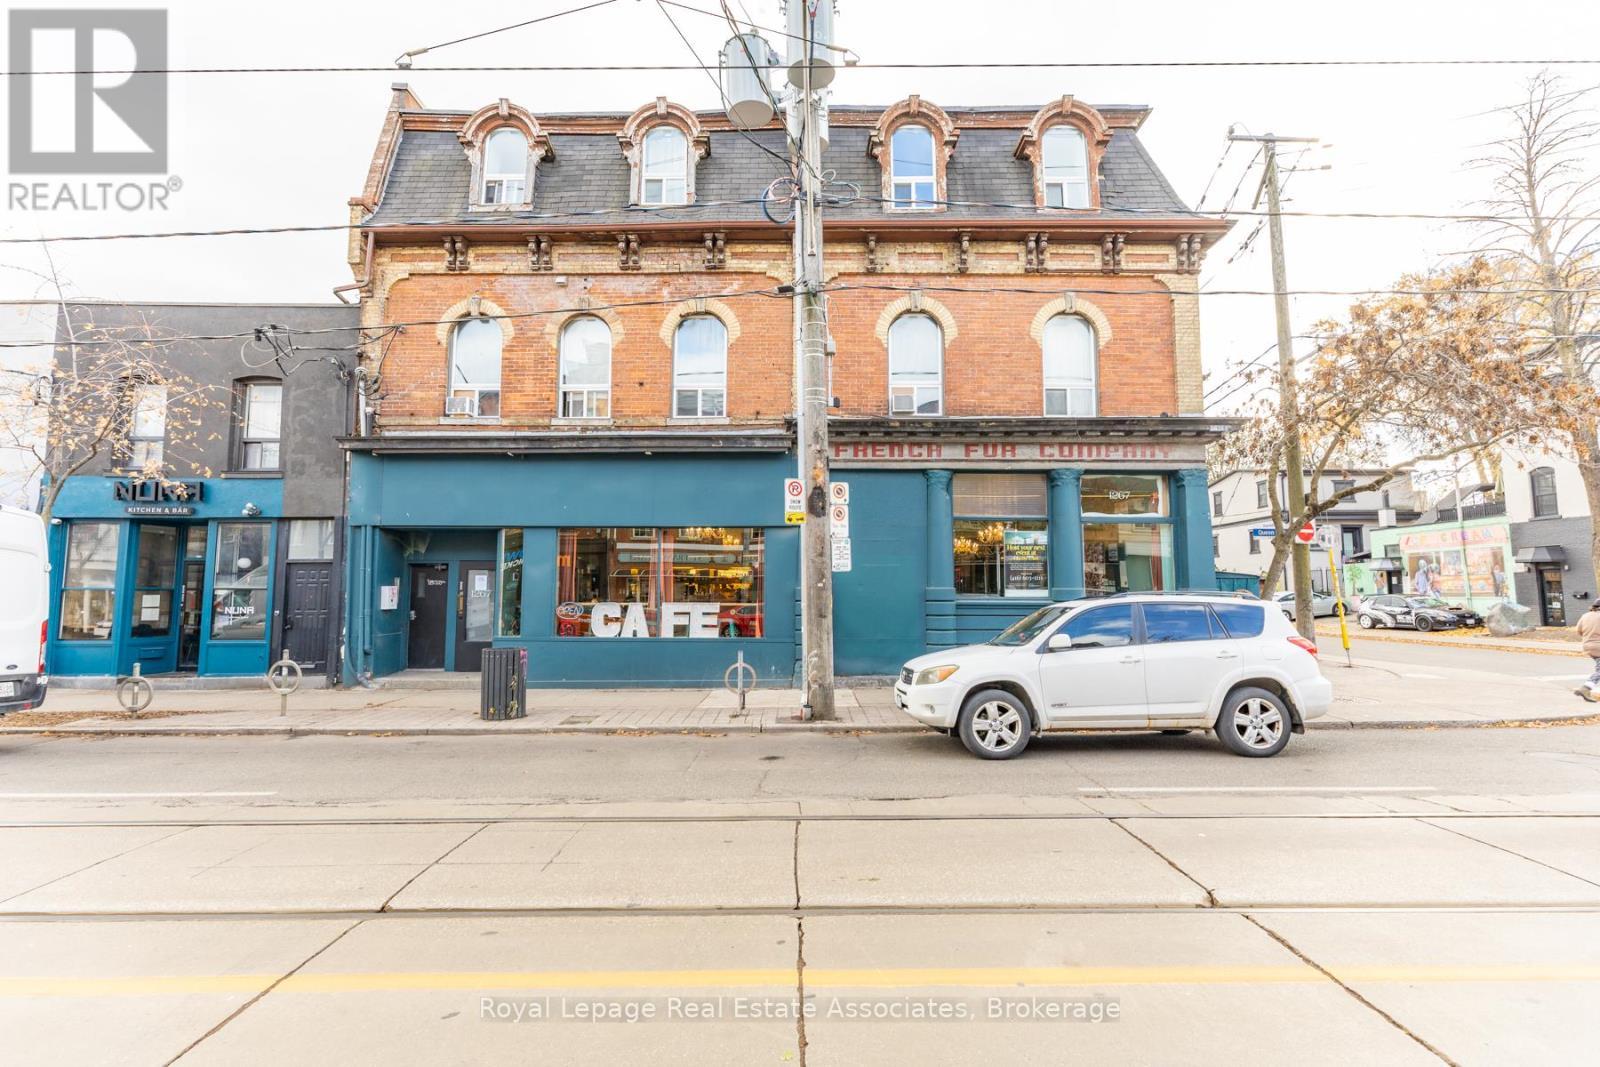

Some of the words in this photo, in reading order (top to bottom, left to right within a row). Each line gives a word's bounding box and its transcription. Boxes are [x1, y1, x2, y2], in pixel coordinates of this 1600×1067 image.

[834, 443, 943, 458] FRENCH
[964, 443, 1017, 458] FUR
[1039, 443, 1172, 458] COMPANY
[1109, 490, 1131, 500] 1267
[224, 606, 255, 614] NUNA
[591, 602, 721, 638] CAFE
